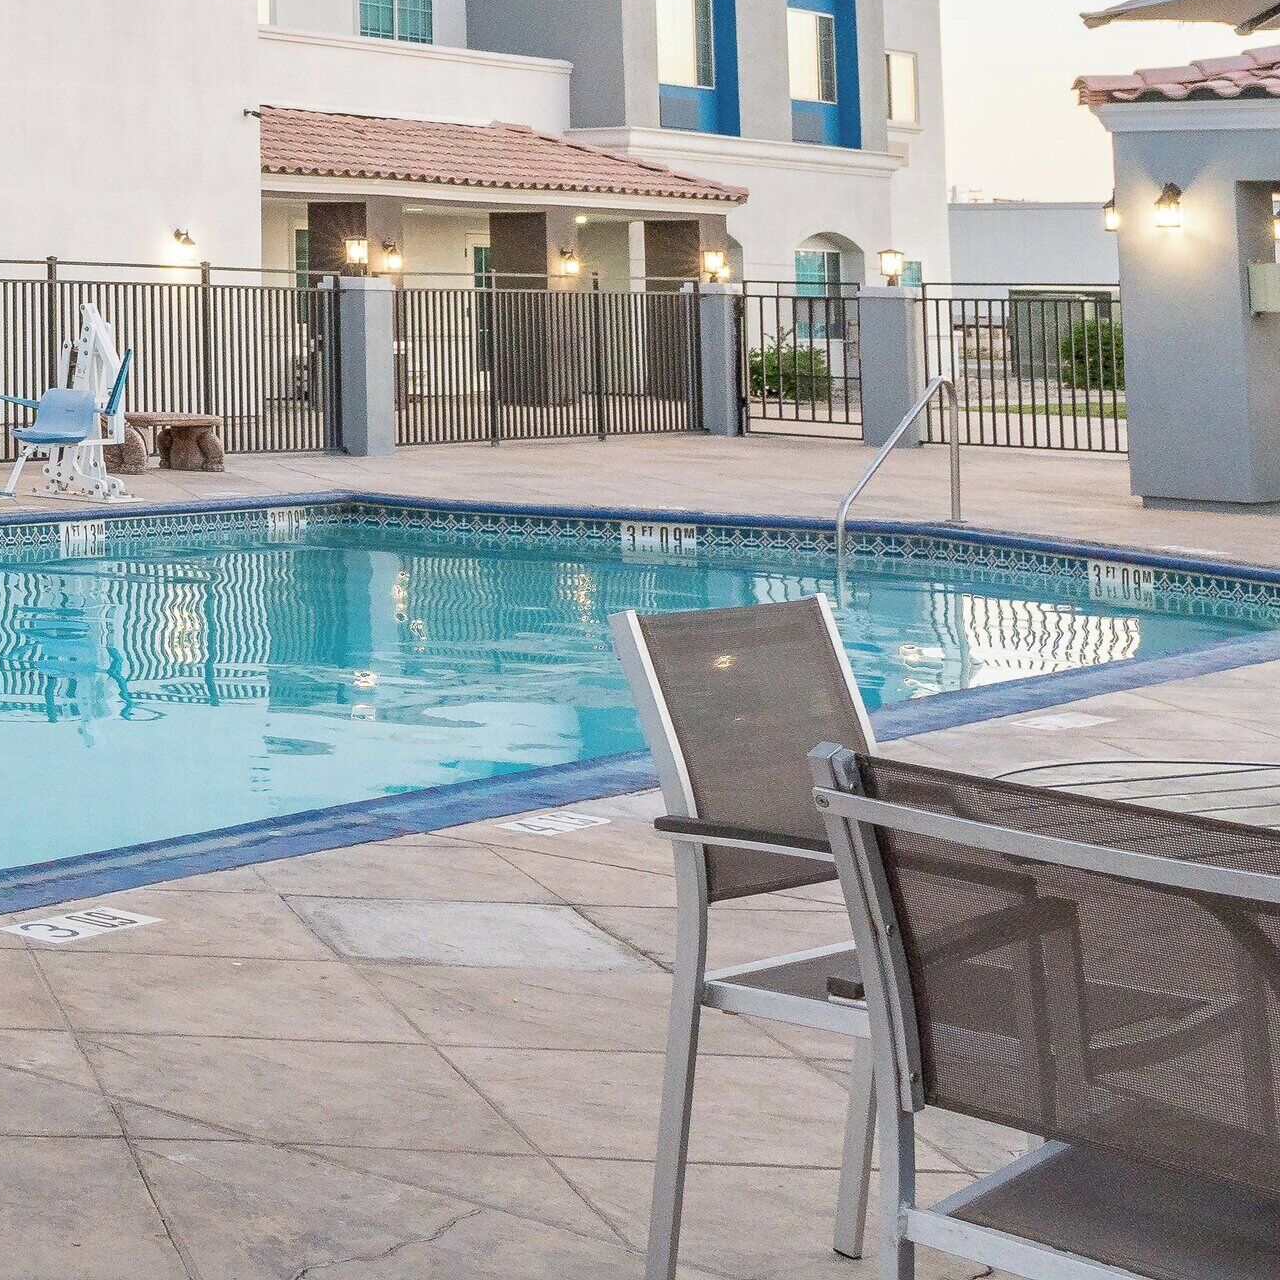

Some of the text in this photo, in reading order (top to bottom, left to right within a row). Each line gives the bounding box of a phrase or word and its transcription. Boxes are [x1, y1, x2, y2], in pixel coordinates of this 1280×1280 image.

[72, 524, 80, 537] FT
[626, 524, 636, 542] 3
[641, 525, 654, 537] FT
[1093, 564, 1101, 583] 3
[1105, 565, 1116, 578] FT
[19, 923, 80, 938] 3
